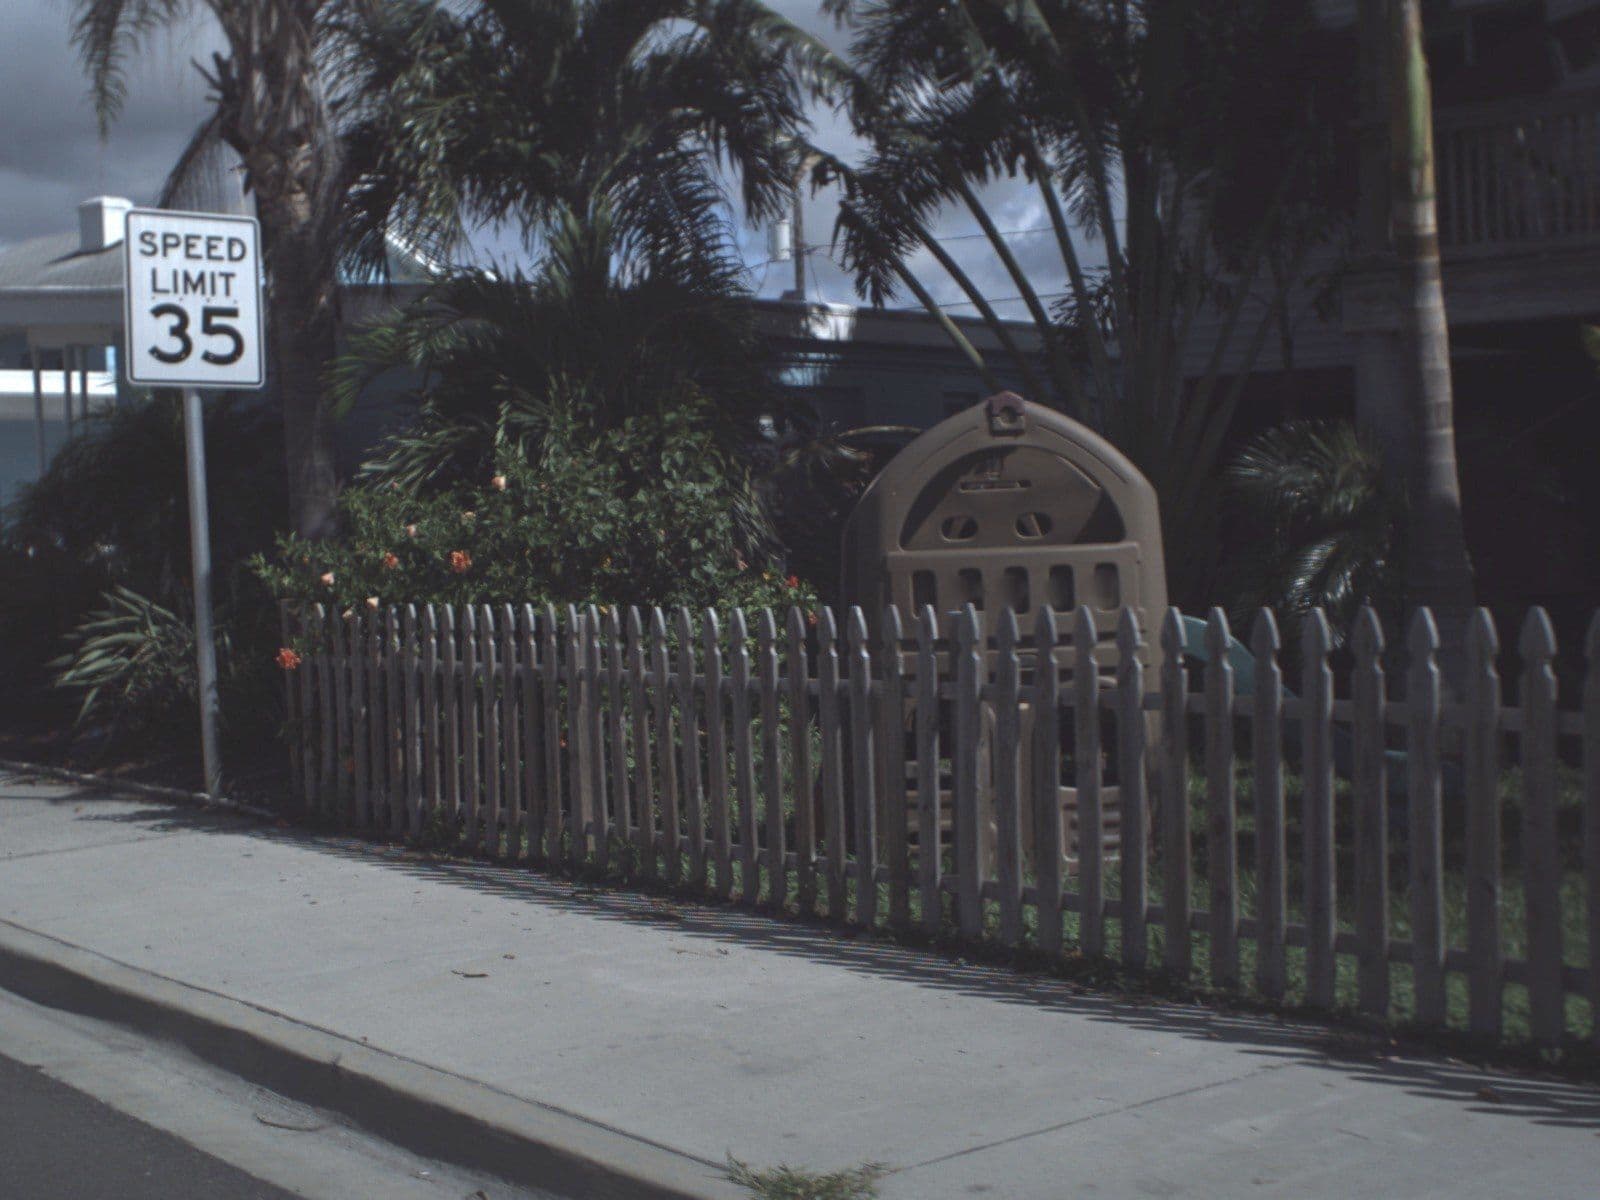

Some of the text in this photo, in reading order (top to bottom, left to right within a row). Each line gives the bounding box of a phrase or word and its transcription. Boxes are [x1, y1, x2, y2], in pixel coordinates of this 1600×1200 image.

[139, 231, 246, 262] SPEED
[152, 268, 236, 297] LIMIT
[148, 303, 245, 366] 35
